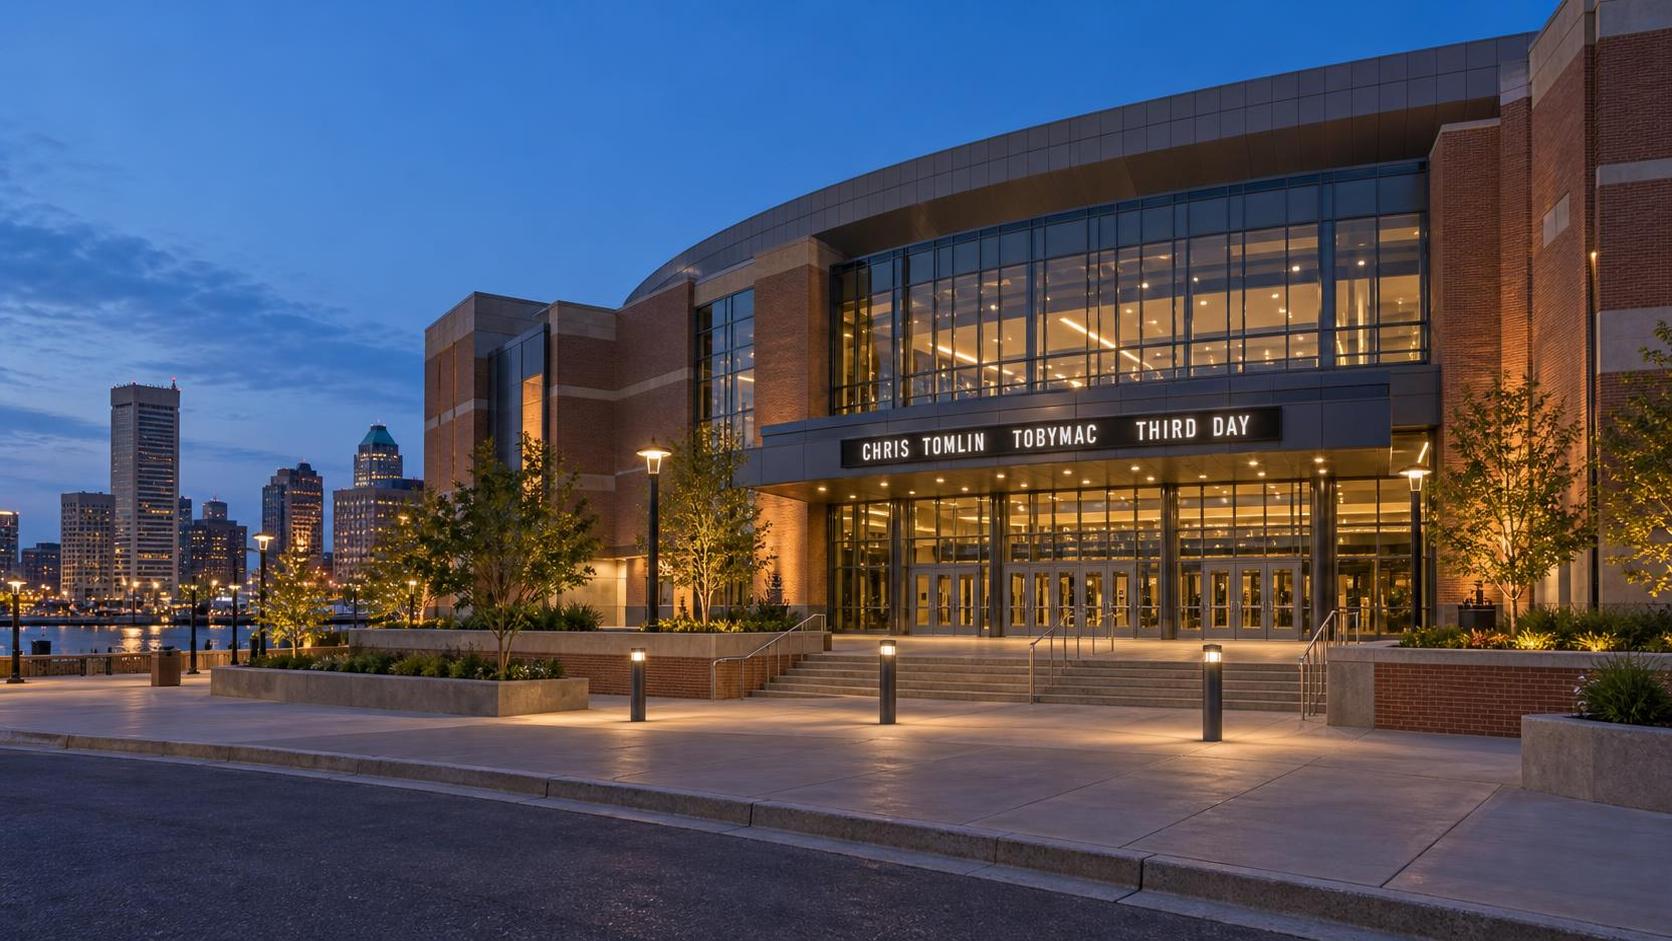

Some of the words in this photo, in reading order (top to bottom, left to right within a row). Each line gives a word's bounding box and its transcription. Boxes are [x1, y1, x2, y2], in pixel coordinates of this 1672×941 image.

[862, 439, 910, 461] CHRIS
[922, 432, 985, 456] TOMLIN
[1012, 424, 1097, 449] TOBYMAC
[1136, 418, 1197, 441] THIRD
[1213, 415, 1250, 437] DAY
